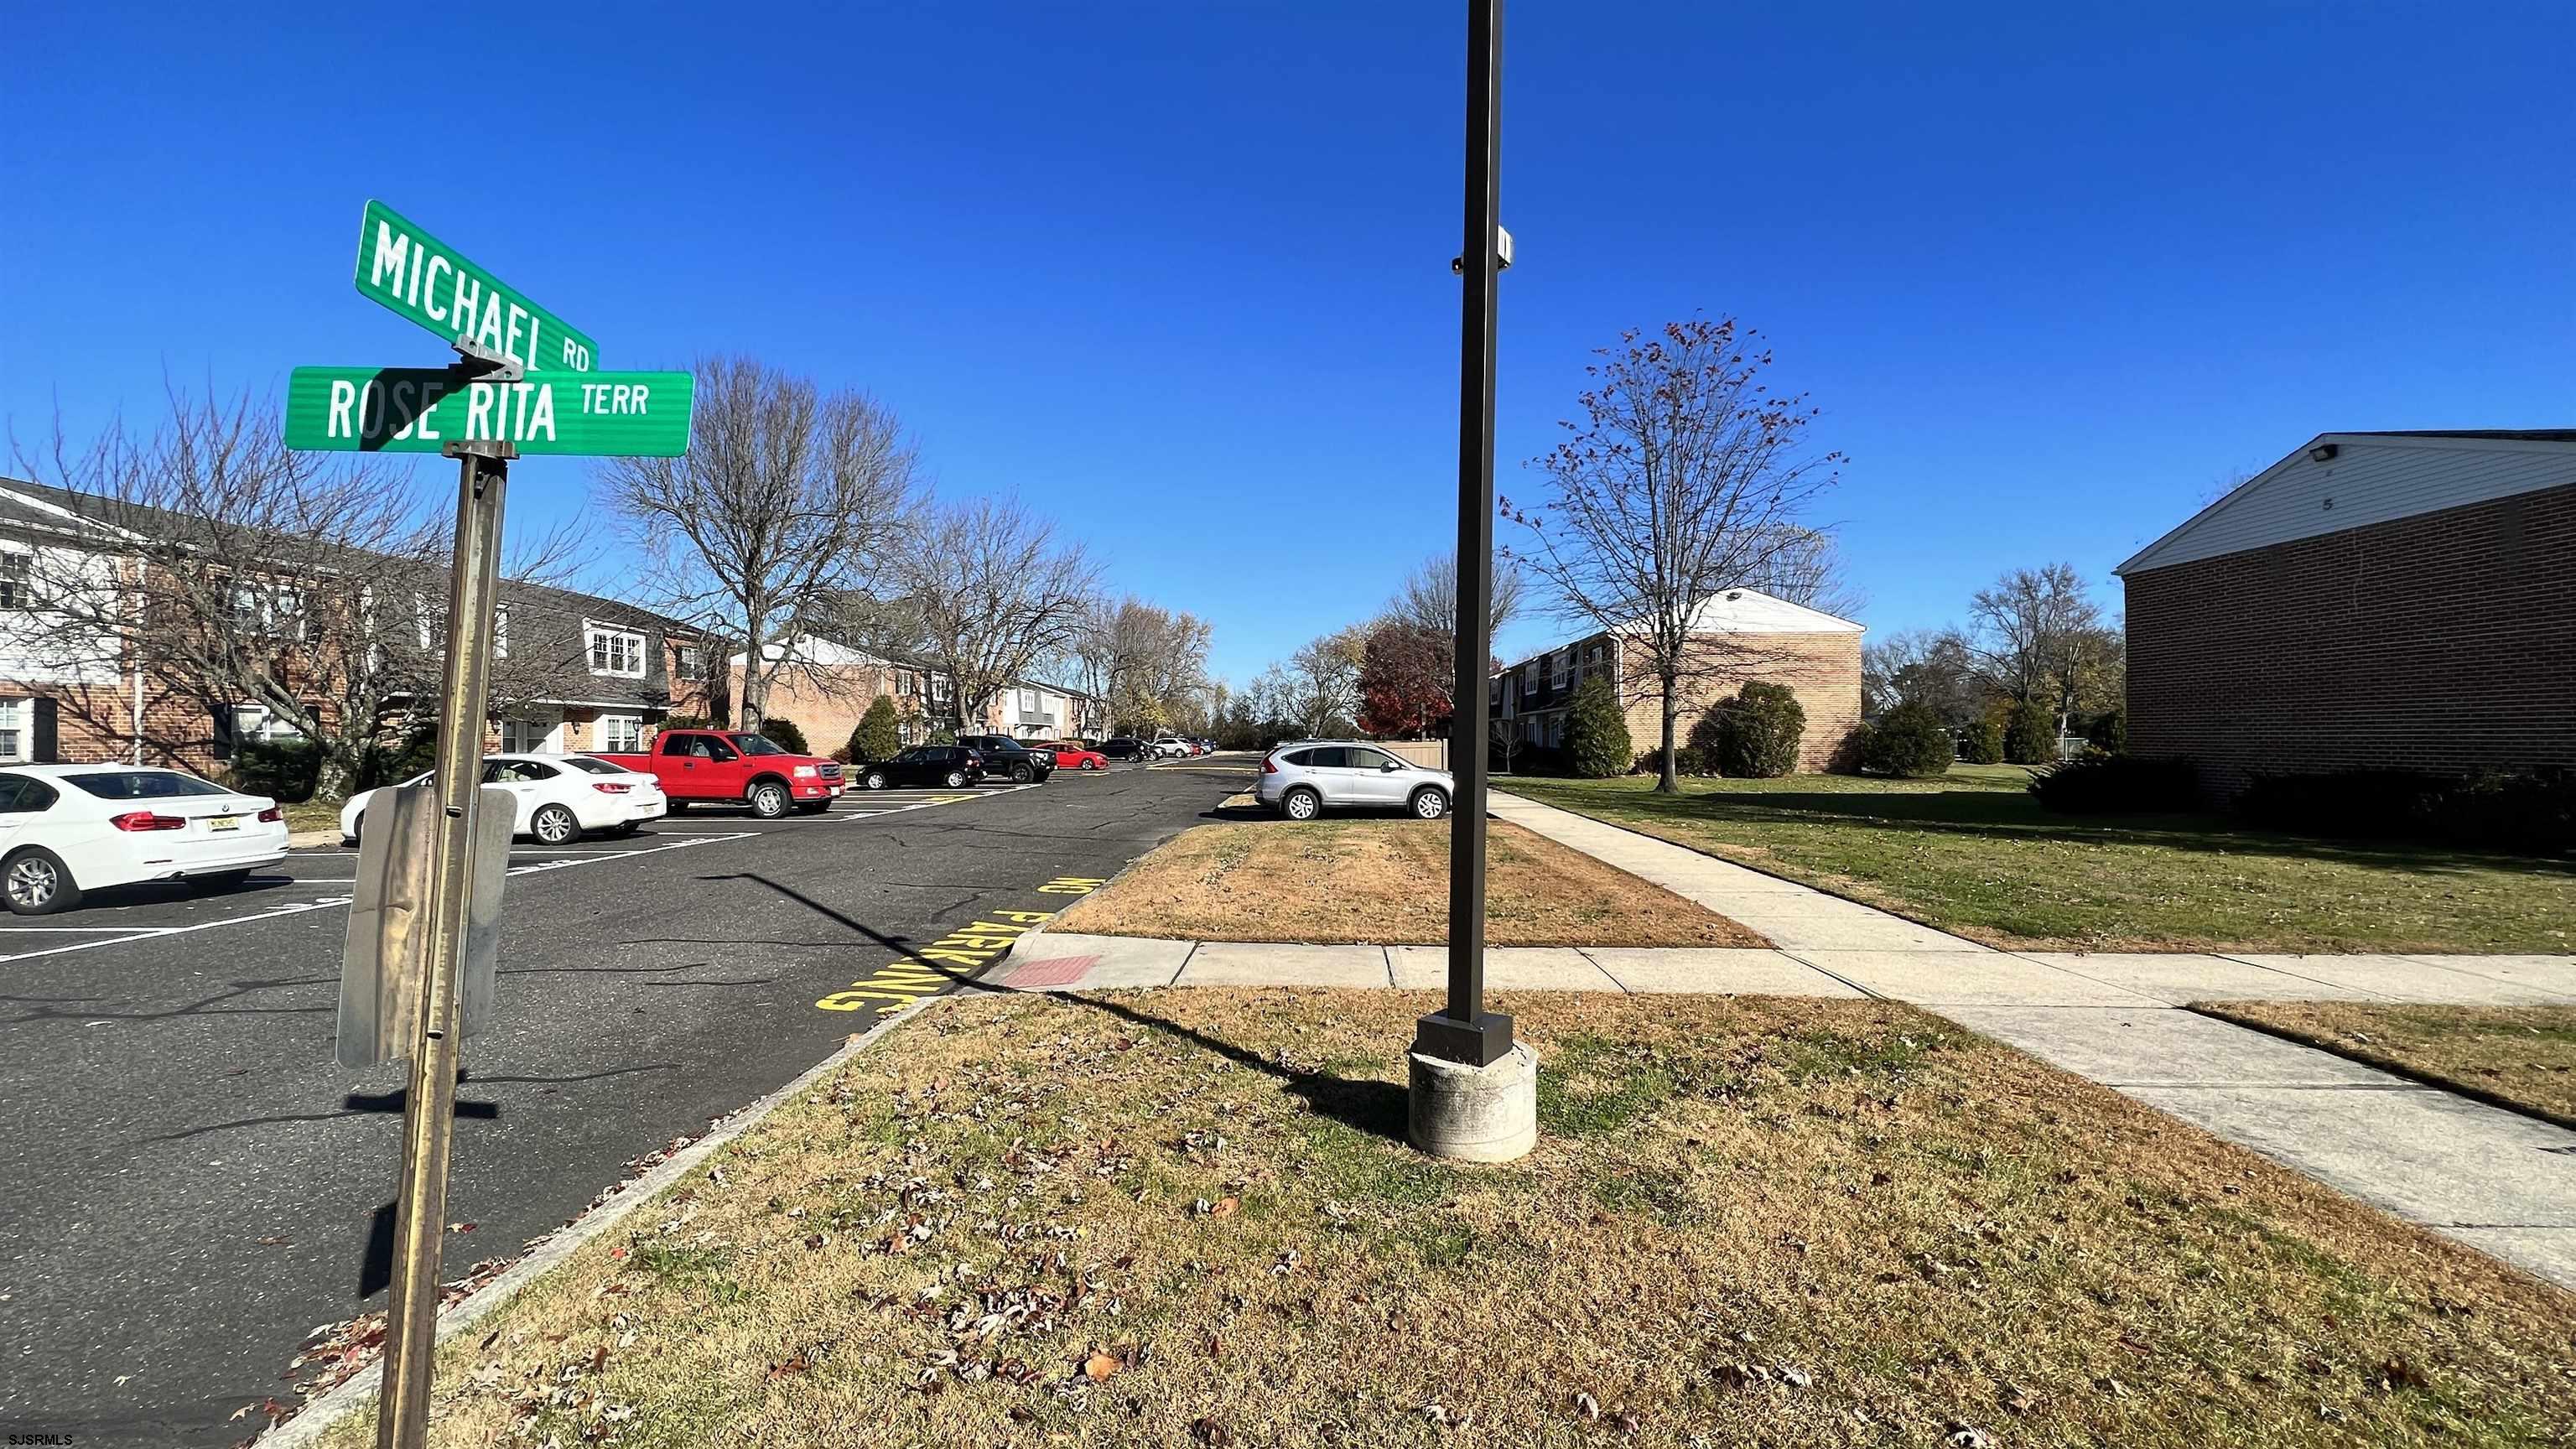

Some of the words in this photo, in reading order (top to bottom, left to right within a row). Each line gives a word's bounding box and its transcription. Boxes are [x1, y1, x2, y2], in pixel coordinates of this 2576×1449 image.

[371, 219, 541, 371] MICHAEL
[563, 336, 589, 372] RD
[328, 380, 444, 440] ROSE
[465, 383, 557, 442] RITA
[581, 384, 649, 414] TERR
[1037, 877, 1106, 894] NO
[814, 909, 1054, 1013] PARKING
